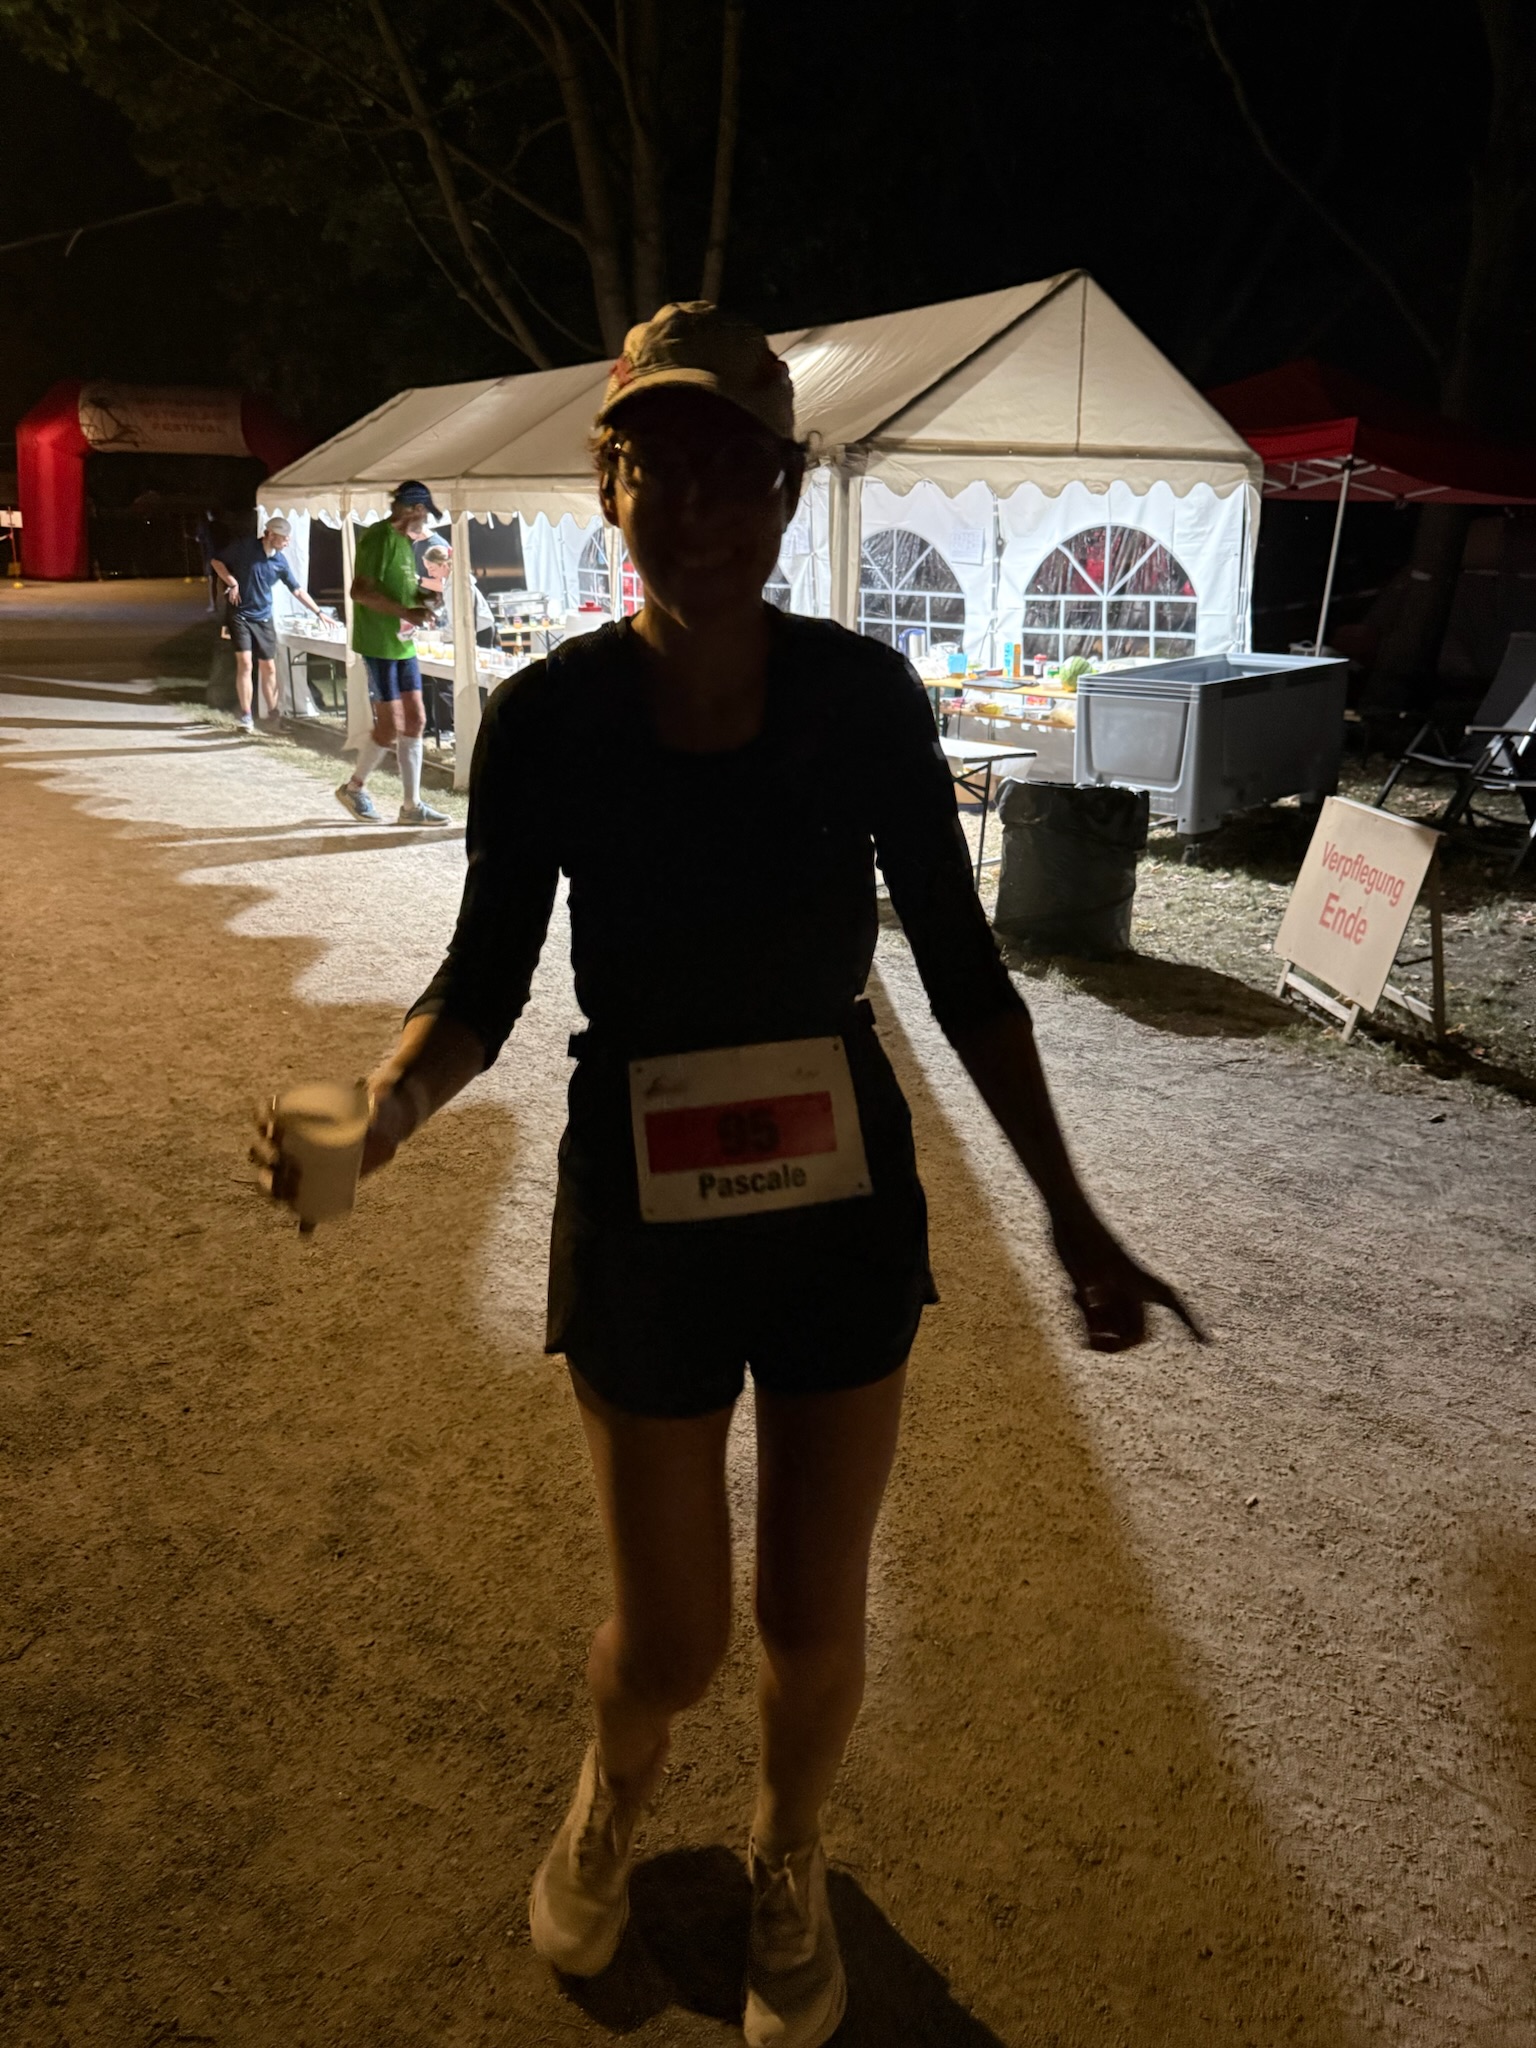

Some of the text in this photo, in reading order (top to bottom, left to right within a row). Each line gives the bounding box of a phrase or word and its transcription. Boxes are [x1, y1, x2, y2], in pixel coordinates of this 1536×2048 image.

[1323, 842, 1405, 906] Verpflegung
[1319, 893, 1367, 944] Ende
[718, 1109, 780, 1156] 95
[700, 1165, 806, 1198] Pascale
